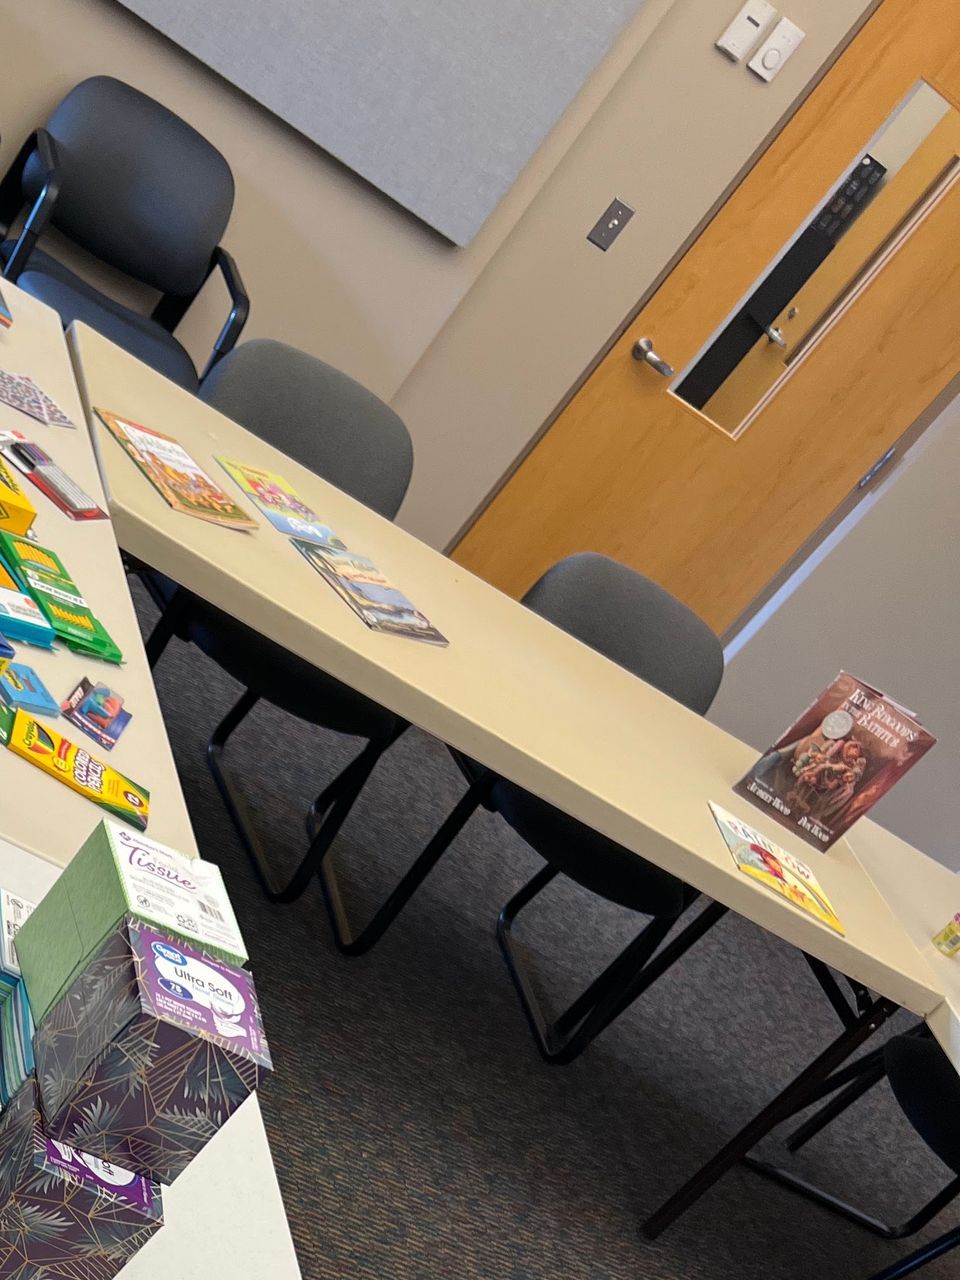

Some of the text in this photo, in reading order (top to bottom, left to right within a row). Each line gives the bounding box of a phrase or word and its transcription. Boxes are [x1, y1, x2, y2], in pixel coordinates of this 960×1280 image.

[120, 840, 197, 891] Tissue
[174, 966, 205, 989] Ultra
[207, 981, 233, 1002] Soft
